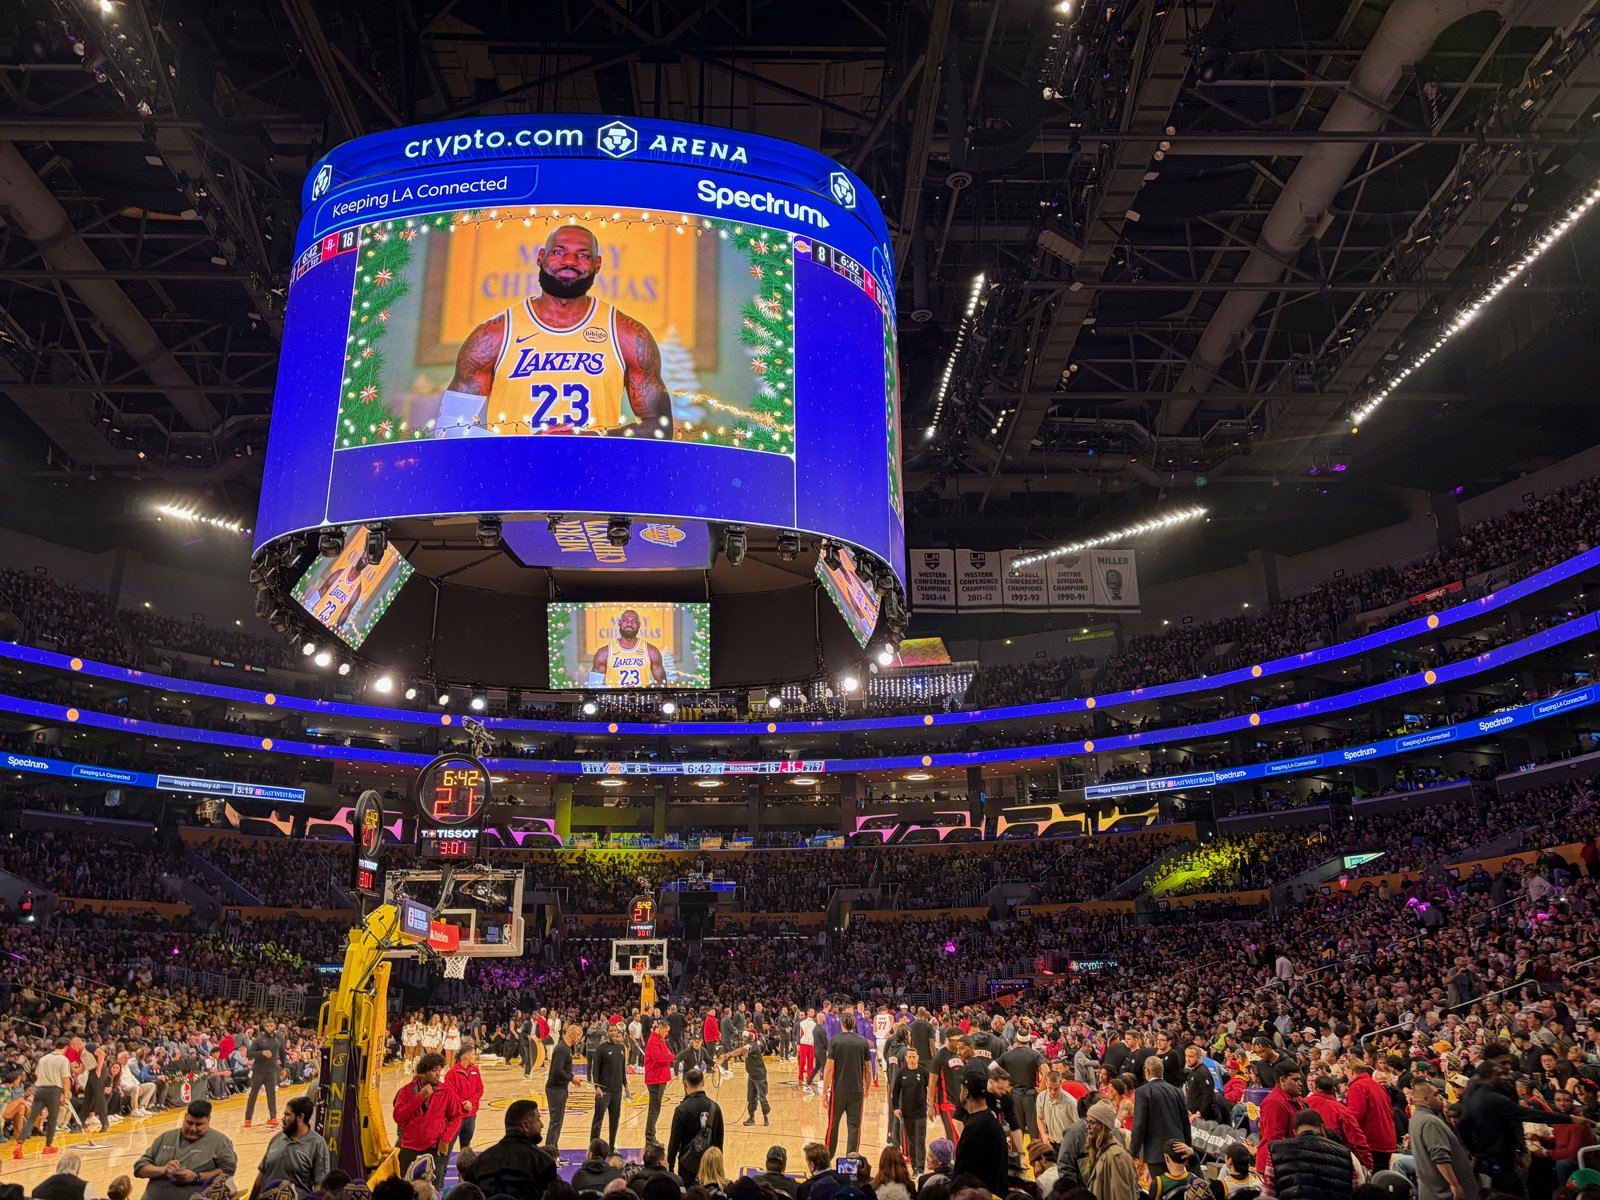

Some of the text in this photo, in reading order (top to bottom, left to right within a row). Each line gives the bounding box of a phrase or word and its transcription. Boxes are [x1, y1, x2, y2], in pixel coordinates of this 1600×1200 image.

[404, 125, 749, 165] crypto.com ARENA
[331, 174, 509, 220] Keeping LA Connected
[697, 178, 823, 228] Spectrum
[342, 231, 354, 248] 18
[818, 246, 826, 262] 8
[840, 255, 860, 275] 6:42
[585, 330, 607, 339] bibigo
[508, 347, 605, 380] LAKERS
[530, 383, 591, 432] 23
[1097, 556, 1129, 566] MILLER
[921, 593, 947, 601] 2013-14
[967, 593, 993, 601] 2011-12
[1011, 593, 1040, 601] 1992-93
[1057, 593, 1086, 601] 1990-91
[612, 657, 644, 669] LAKERS
[619, 669, 640, 686] 23
[1539, 703, 1557, 713] Keeping
[1563, 693, 1588, 706] Connected
[1479, 716, 1511, 731] Spectrum
[1402, 738, 1420, 747] Keeping
[1426, 731, 1451, 742] Connected
[1344, 748, 1375, 760] Spectrum
[7, 756, 46, 769] Spectrum
[634, 764, 641, 773] 8
[687, 764, 711, 773] 6:42
[765, 763, 776, 772] 18
[443, 770, 479, 787] 6:42
[1215, 770, 1244, 781] Spectrum
[237, 786, 254, 795] 5:19
[1150, 781, 1166, 790] 5:19
[433, 787, 474, 816] 21
[436, 829, 479, 839] TISSOT
[440, 841, 468, 855] 3:01
[634, 908, 650, 921] 21
[878, 1021, 888, 1030] 77
